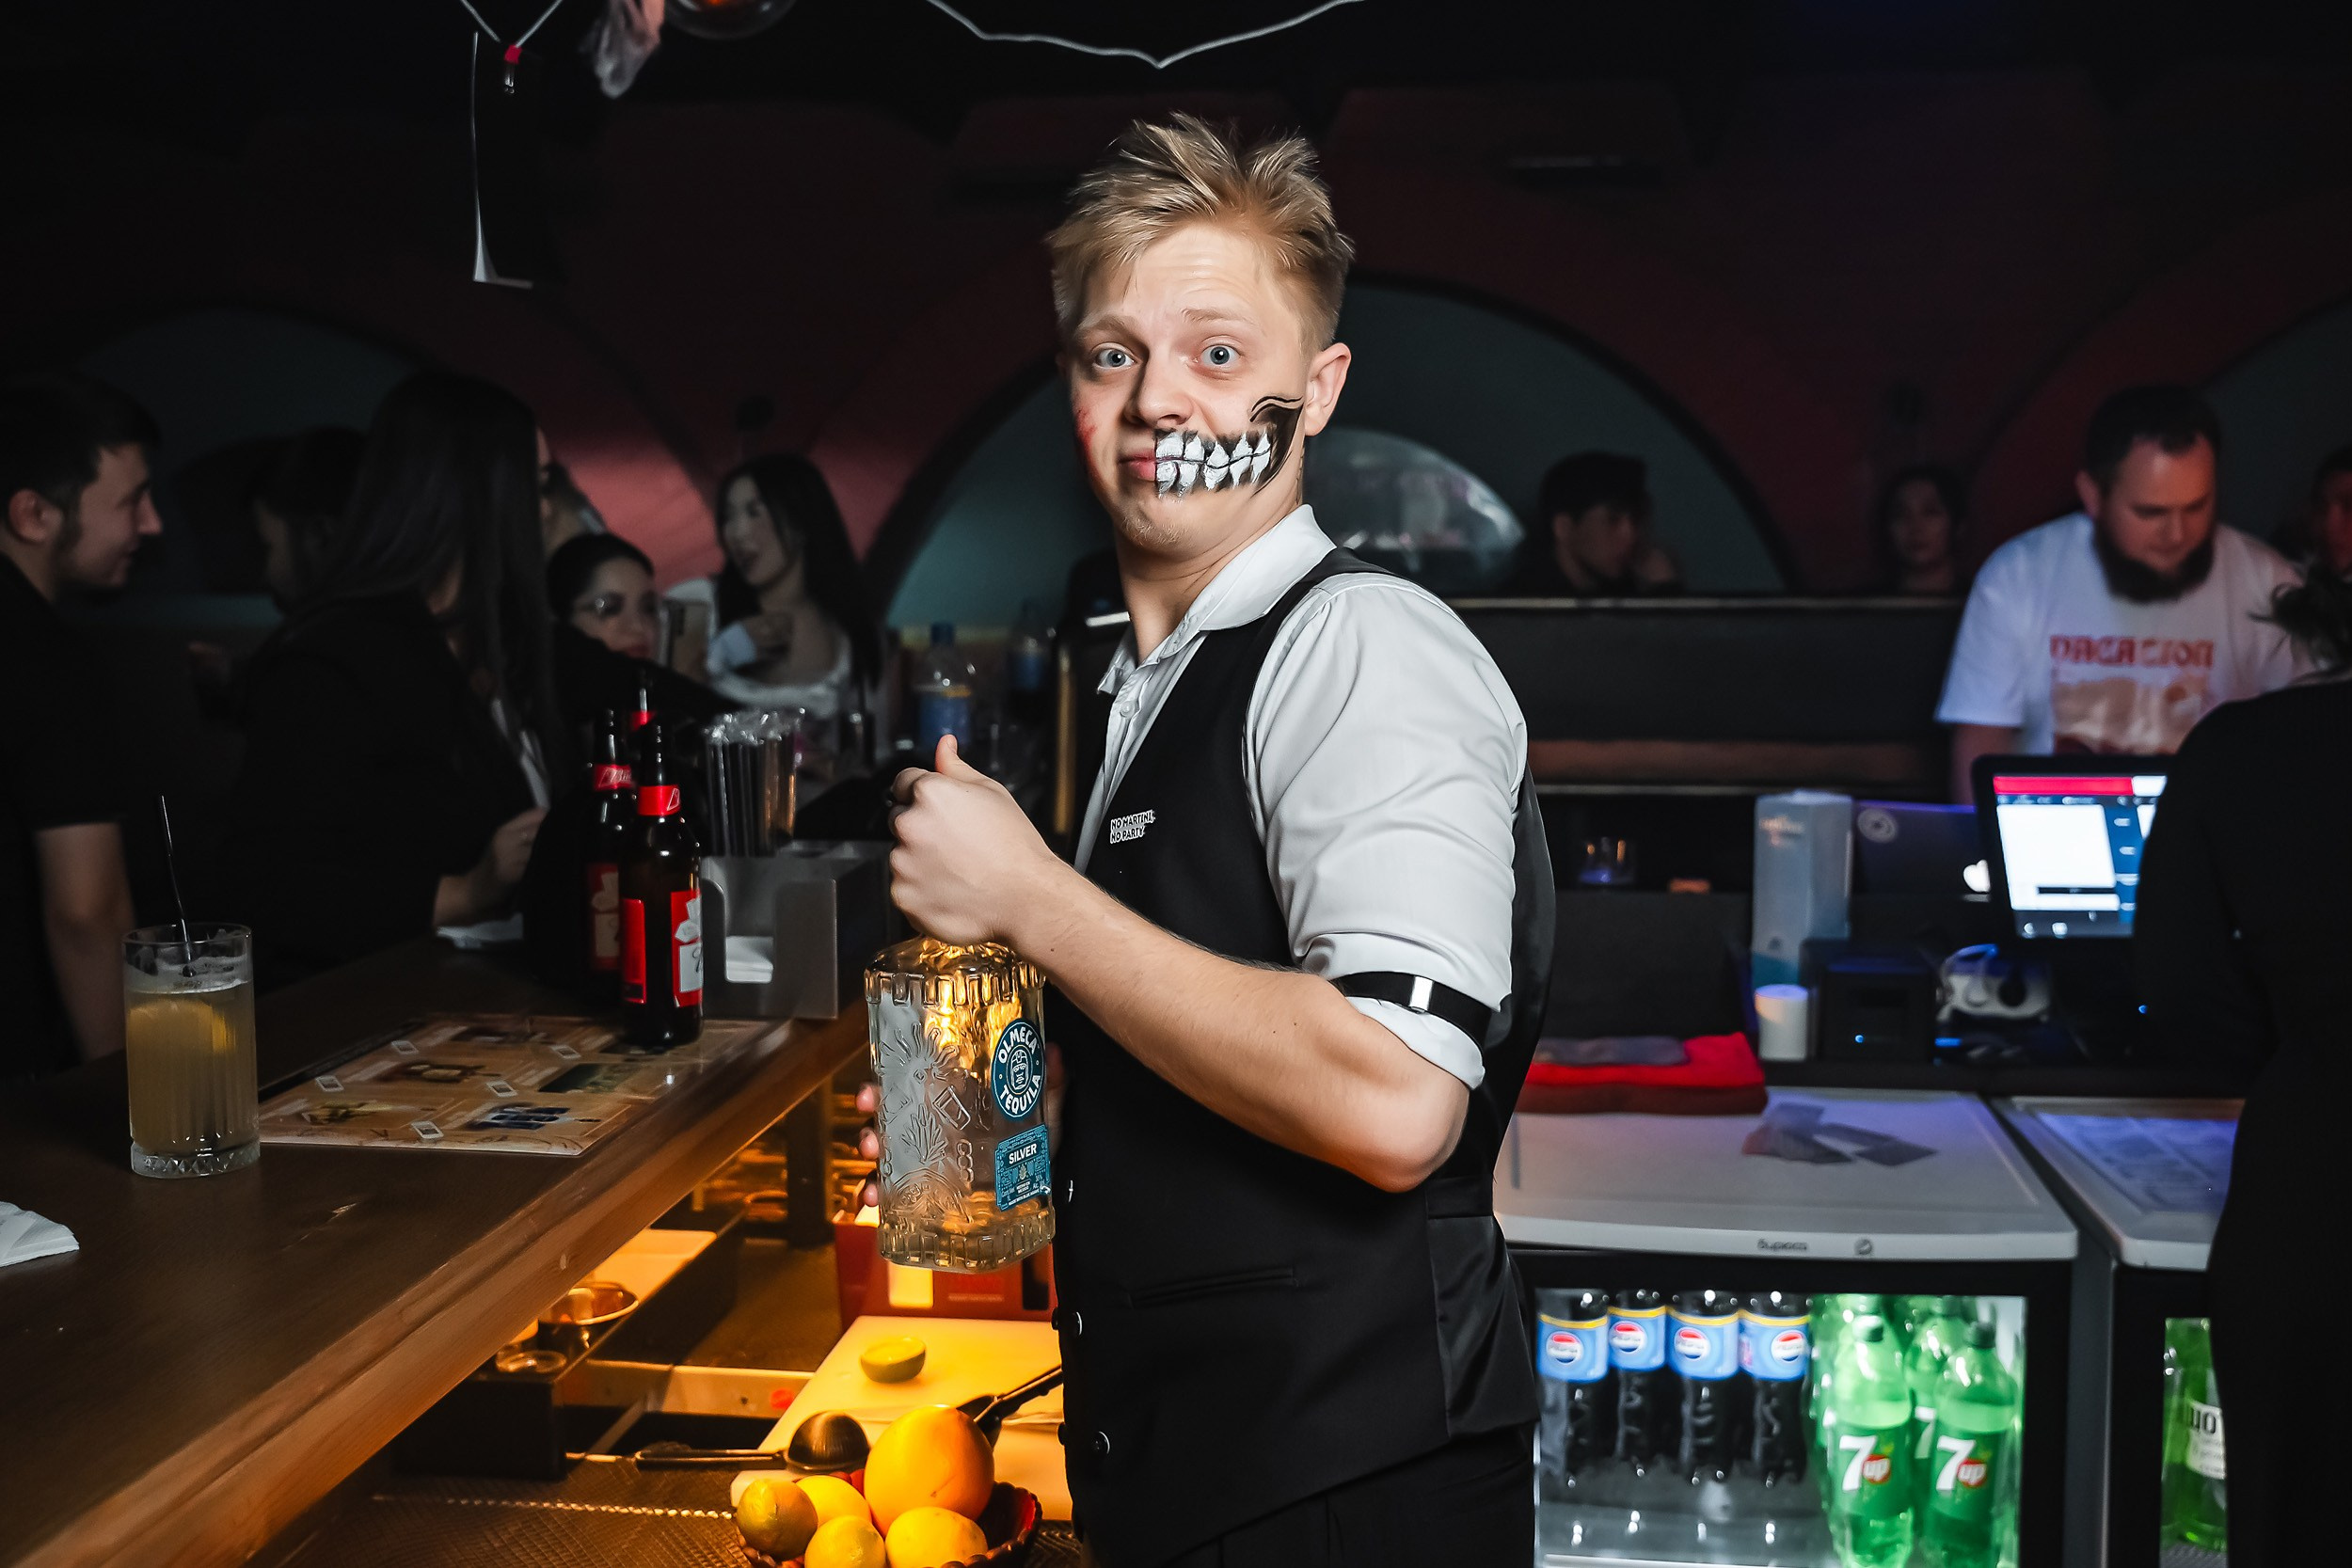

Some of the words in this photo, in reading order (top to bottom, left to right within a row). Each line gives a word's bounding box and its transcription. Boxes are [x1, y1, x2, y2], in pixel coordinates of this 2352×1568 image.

[1111, 819, 1121, 830] NO
[1111, 832, 1121, 842] NO
[998, 1026, 1038, 1064] OLMECA
[999, 1074, 1041, 1115] TEQUILA
[1009, 1143, 1038, 1164] SILVER
